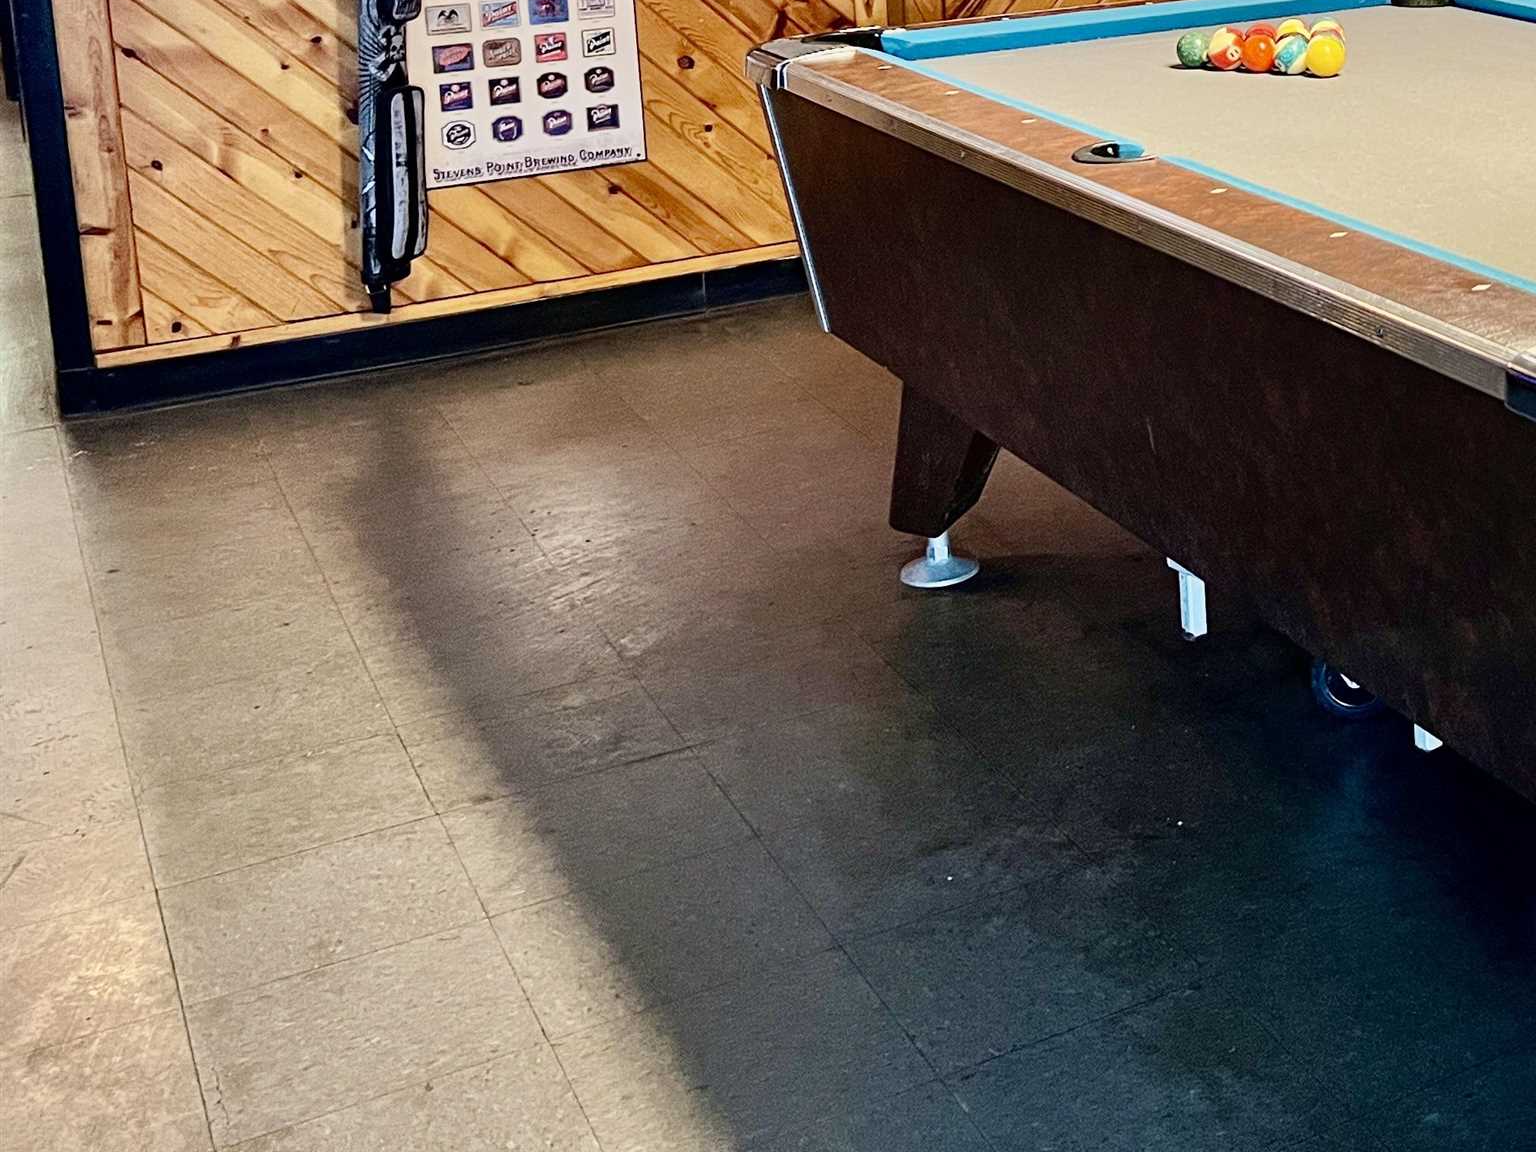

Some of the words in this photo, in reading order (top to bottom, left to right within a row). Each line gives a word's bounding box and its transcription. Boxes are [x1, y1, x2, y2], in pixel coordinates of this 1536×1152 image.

[433, 167, 482, 181] STEVENS
[487, 161, 521, 174] POINT
[579, 147, 631, 161] COMPANY
